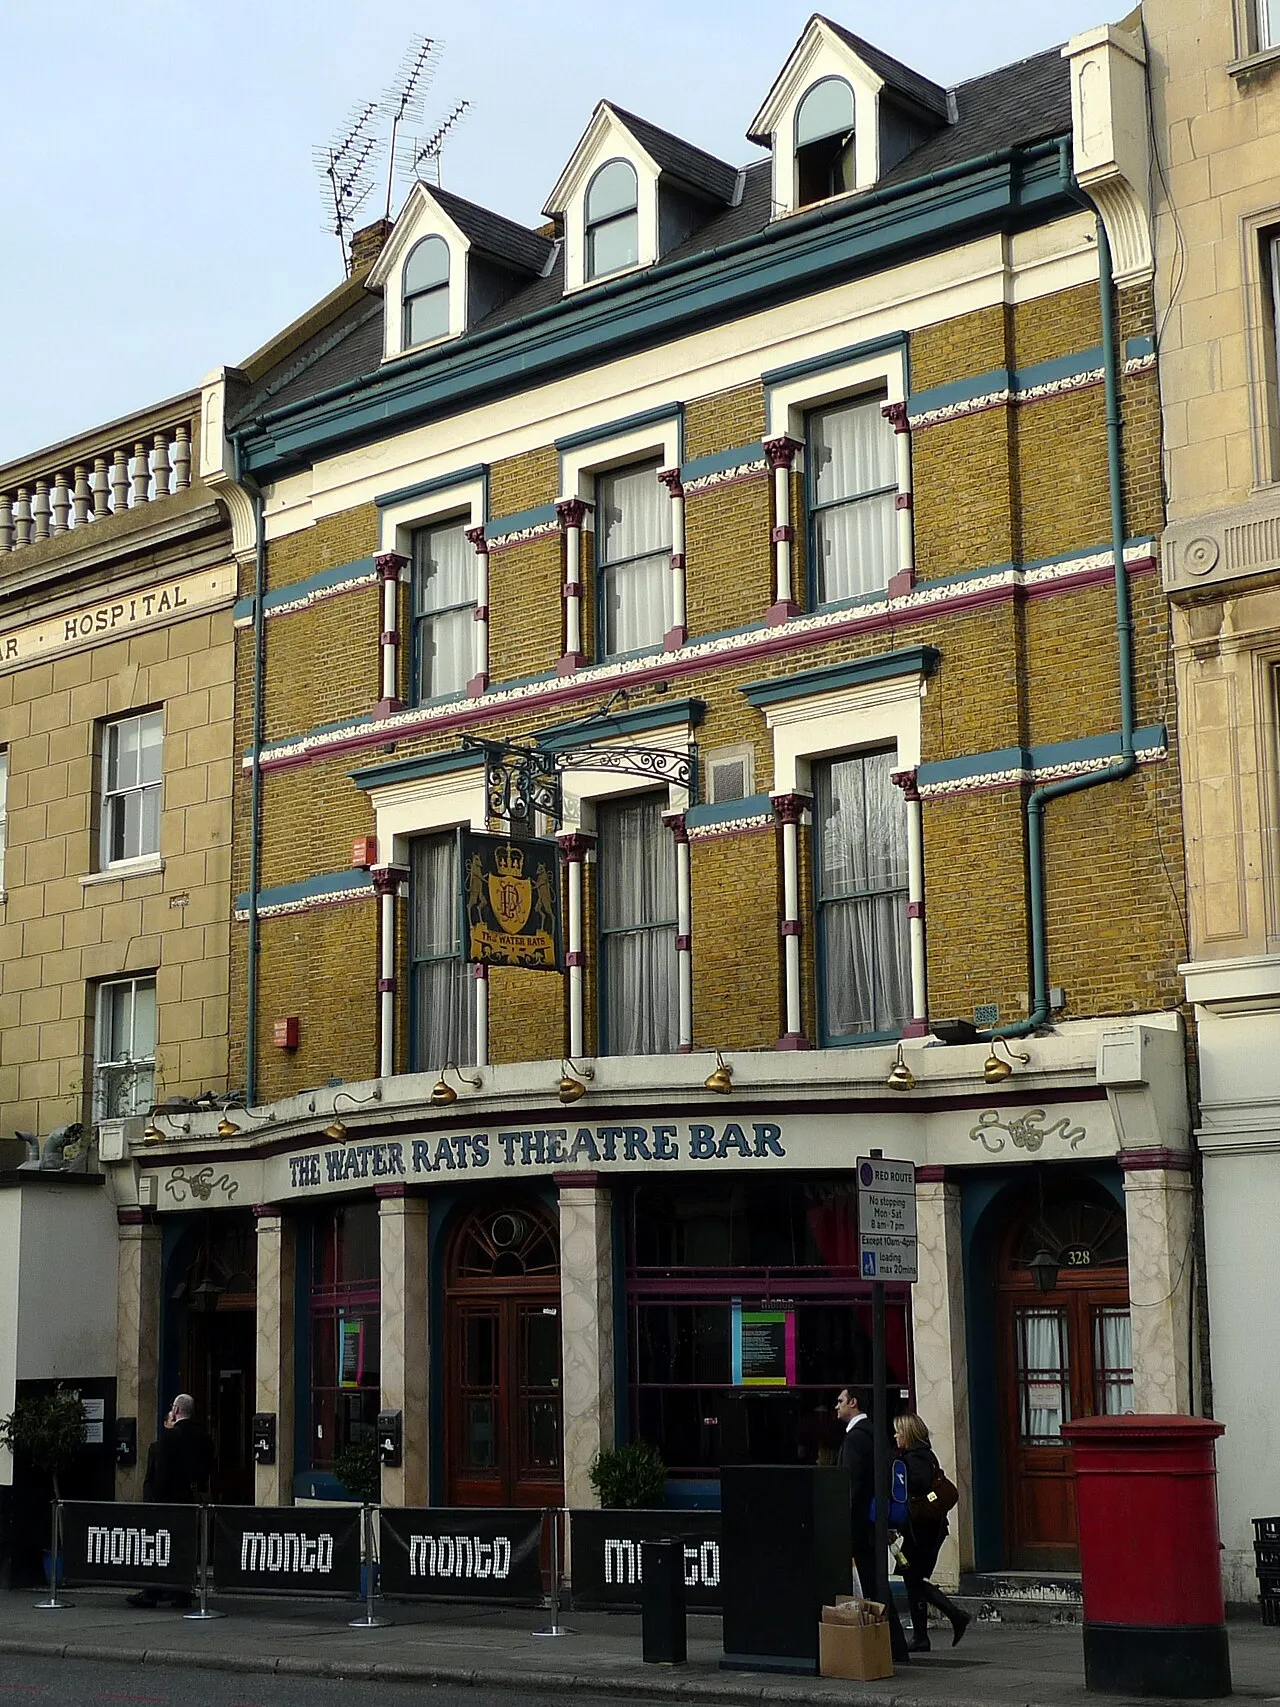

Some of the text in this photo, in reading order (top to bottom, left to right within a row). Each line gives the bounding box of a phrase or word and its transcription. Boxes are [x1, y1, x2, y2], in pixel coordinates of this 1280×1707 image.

[0, 586, 188, 661] R HOSPITAL
[499, 936, 525, 946] WATER
[527, 937, 546, 946] RATS
[289, 1123, 786, 1188] THE WATER RATS THEATRE BAR
[875, 1170, 912, 1183] RED ROUTE
[869, 1195, 906, 1209] No stopping
[862, 1235, 883, 1246] Except
[1068, 1251, 1091, 1265] 328
[880, 1266, 893, 1274] max
